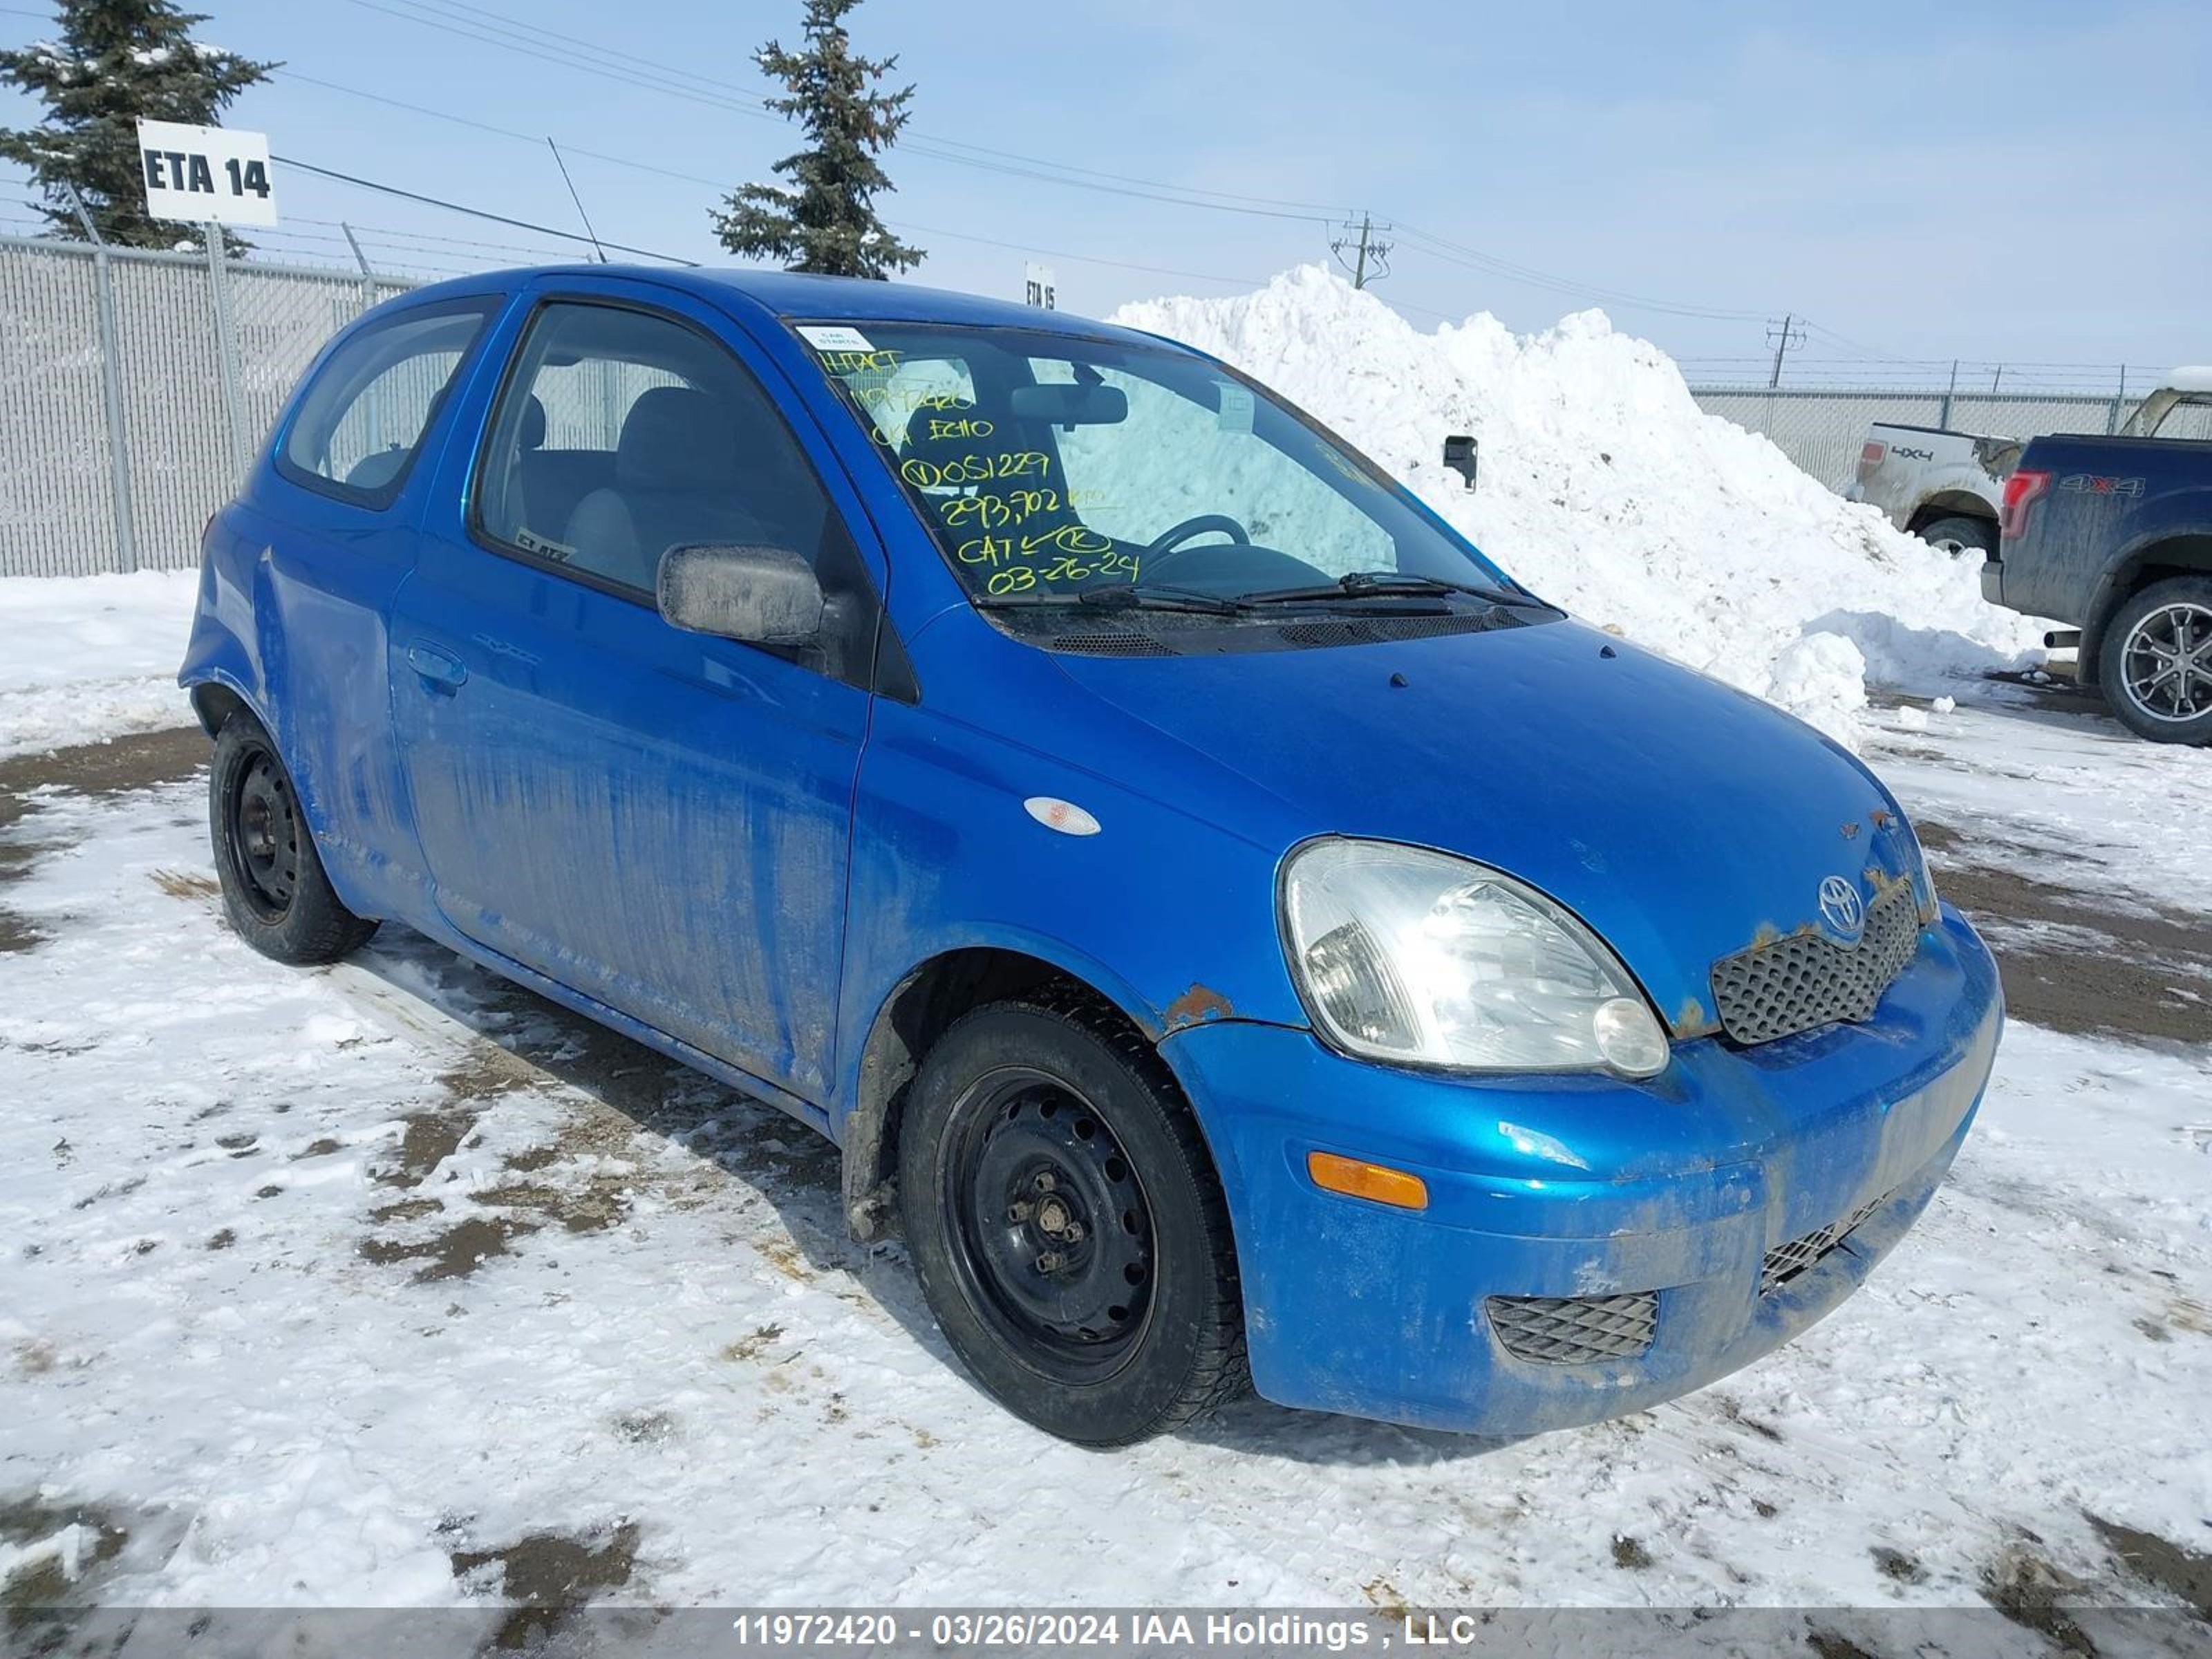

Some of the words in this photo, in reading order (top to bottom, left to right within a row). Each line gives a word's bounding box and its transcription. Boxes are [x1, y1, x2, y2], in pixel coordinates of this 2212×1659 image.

[143, 149, 214, 194] ETA
[225, 158, 270, 198] 14
[1027, 280, 1042, 308] ETA
[1045, 285, 1055, 310] 15
[959, 535, 1013, 566] CAT
[988, 552, 1139, 594] 03-26-24
